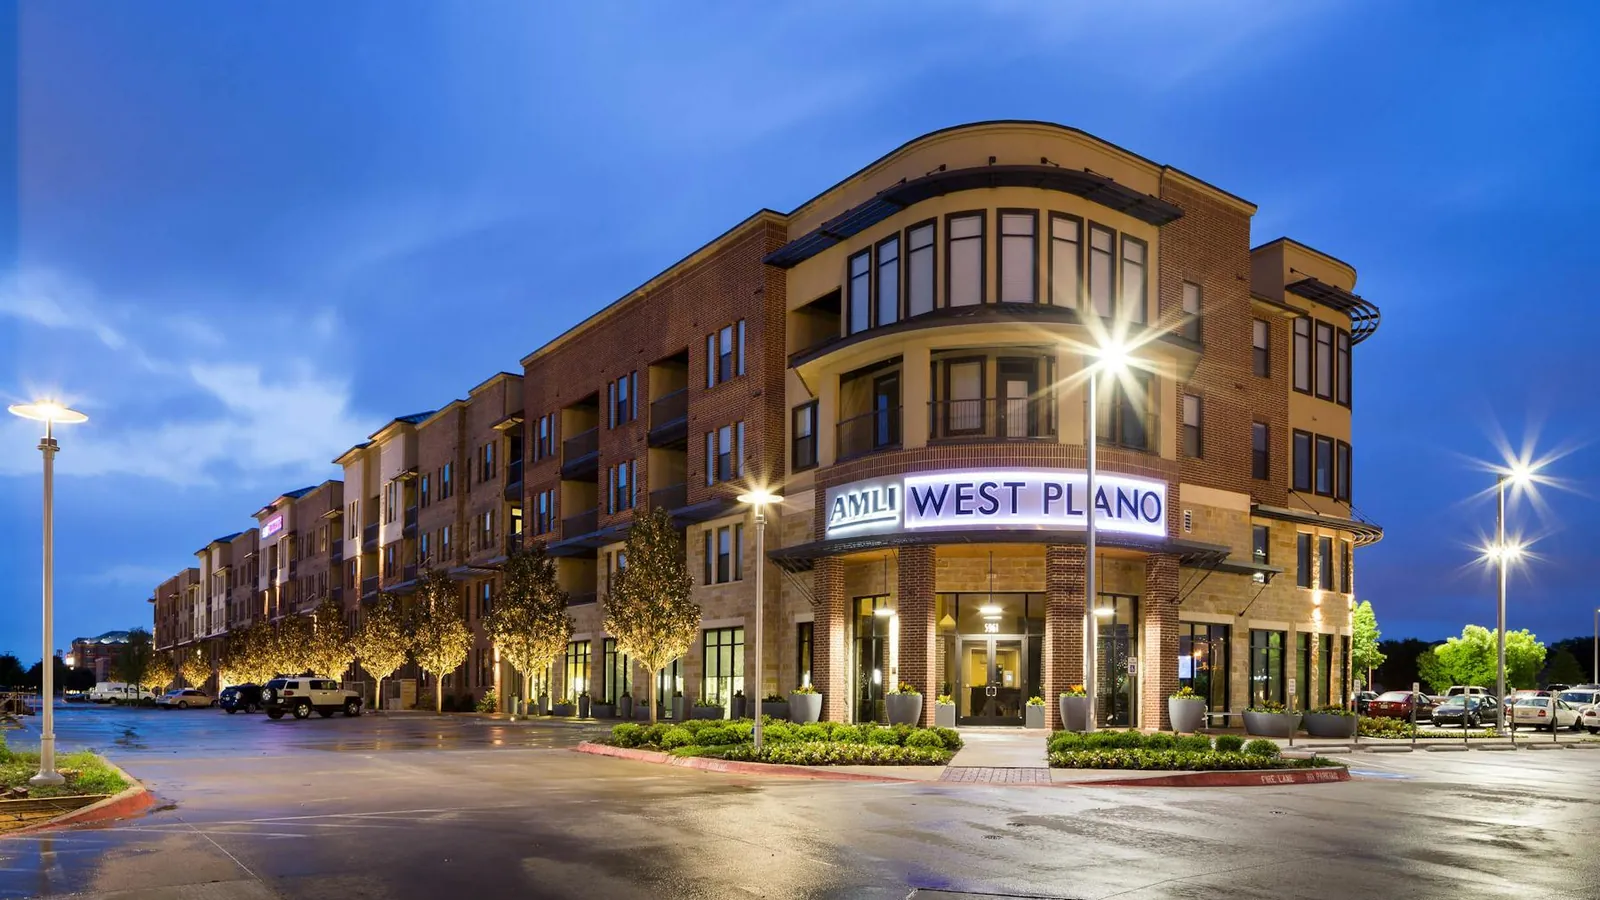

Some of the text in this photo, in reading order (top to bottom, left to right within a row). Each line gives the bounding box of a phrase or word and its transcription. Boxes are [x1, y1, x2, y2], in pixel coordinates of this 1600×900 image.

[830, 482, 1162, 523] AMLI WEST PLANO
[1260, 774, 1276, 784] FIRE
[1277, 774, 1295, 783] LANE
